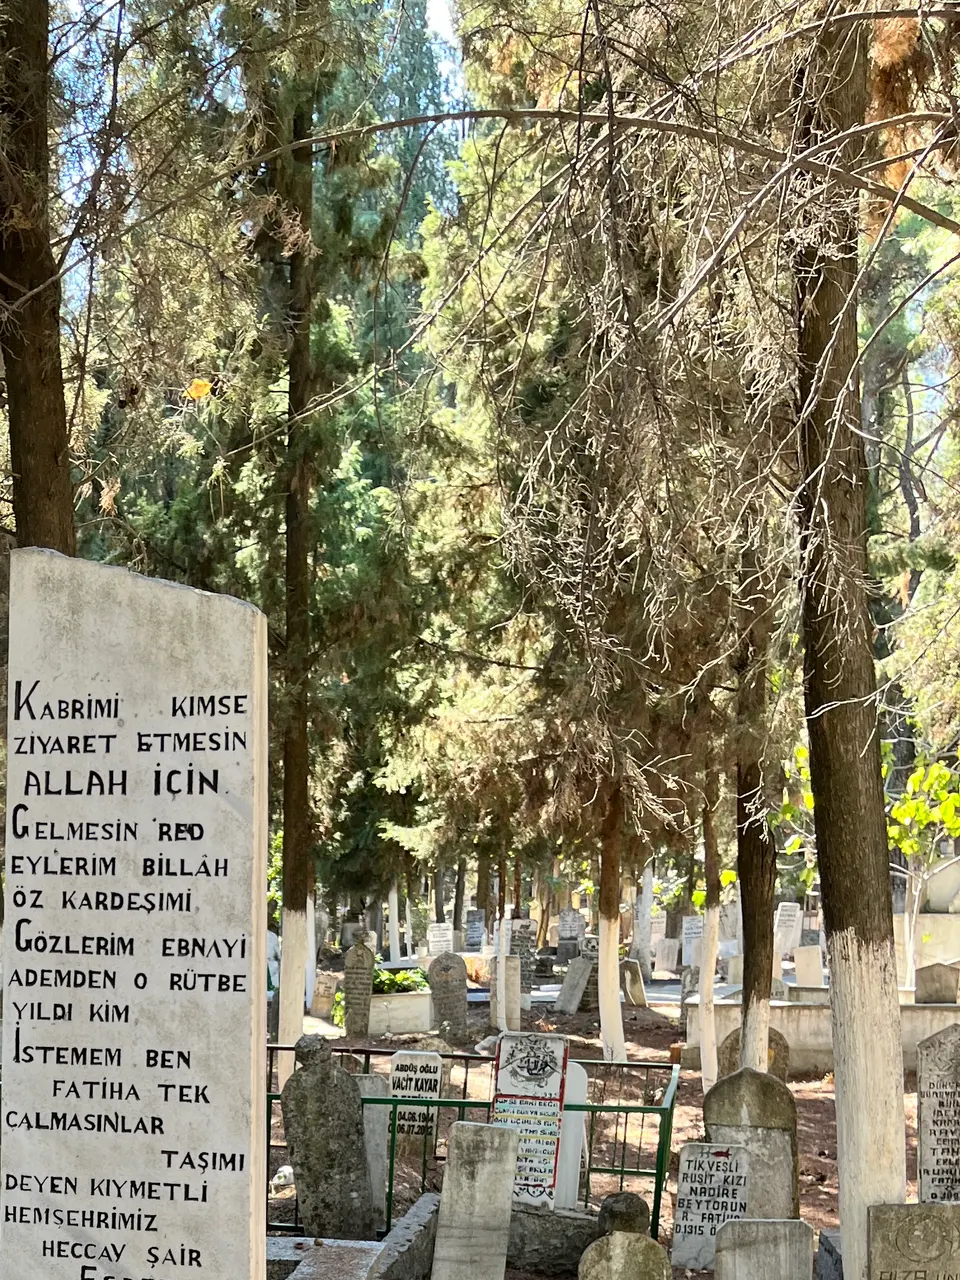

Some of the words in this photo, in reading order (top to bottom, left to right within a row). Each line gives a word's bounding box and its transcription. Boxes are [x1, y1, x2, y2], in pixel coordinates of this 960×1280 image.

[14, 680, 119, 720] KABRİMİ
[171, 695, 248, 718] KIMSE
[14, 731, 117, 755] ZİYARET
[137, 726, 247, 752] ETMESİN
[24, 770, 128, 796] ALLAH
[12, 803, 138, 841] GELMESİN
[158, 823, 204, 842] RED
[11, 853, 116, 876] EYLERİM
[142, 852, 228, 877] BİLLÂH
[13, 885, 43, 909] ÖZ
[15, 918, 134, 956] GÖZLERİM
[162, 934, 246, 959] EBNAYİ
[8, 969, 116, 989] ADEMDEN
[134, 972, 147, 990] O
[169, 969, 247, 993] RÜTBE
[12, 1002, 73, 1022] YILDI
[89, 1000, 130, 1023] KİM
[12, 1021, 121, 1067] İSTEMEM
[146, 1050, 191, 1069] BEN
[52, 1077, 140, 1100] FATİHA
[158, 1084, 210, 1103] TEK
[414, 1079, 439, 1093] KAYAR
[161, 1150, 245, 1174] TAŞIMI
[5, 1174, 77, 1195] DEYEN
[90, 1178, 208, 1202] KIYMETLİ
[689, 1185, 738, 1199] NADİRE
[723, 1175, 747, 1187] KIZI
[4, 1205, 158, 1232] HEMŞEHRİMİZ
[42, 1240, 126, 1262] HECCAY
[147, 1243, 202, 1268] ŞAİR
